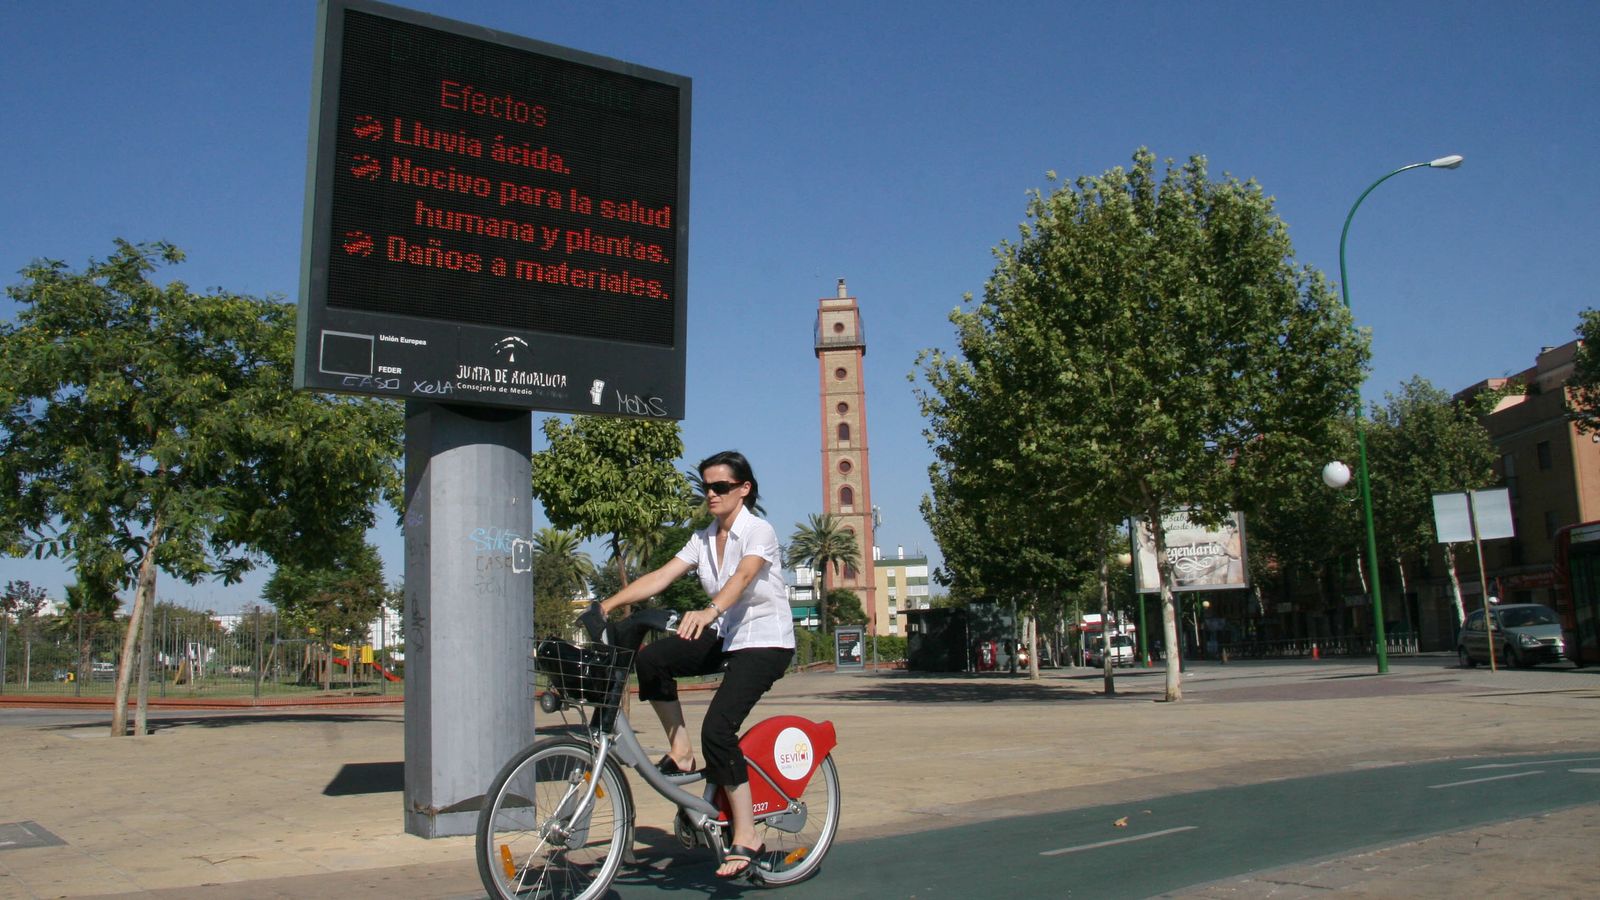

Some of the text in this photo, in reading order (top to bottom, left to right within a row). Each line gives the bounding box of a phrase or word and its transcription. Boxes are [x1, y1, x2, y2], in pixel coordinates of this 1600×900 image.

[442, 80, 544, 126] Efectos
[394, 118, 570, 174] Lluvia ácida.
[391, 157, 671, 228] Nocivo para la salud
[416, 201, 669, 262] humana y plantas.
[388, 236, 669, 298] Daños a materiales.
[379, 334, 427, 346] Unión Europea
[378, 366, 402, 374] FEDER
[456, 365, 491, 382] JUNTA
[495, 368, 508, 384] DE
[510, 387, 533, 395] Medio
[1166, 541, 1219, 564] egendario
[752, 801, 769, 813] 2327
